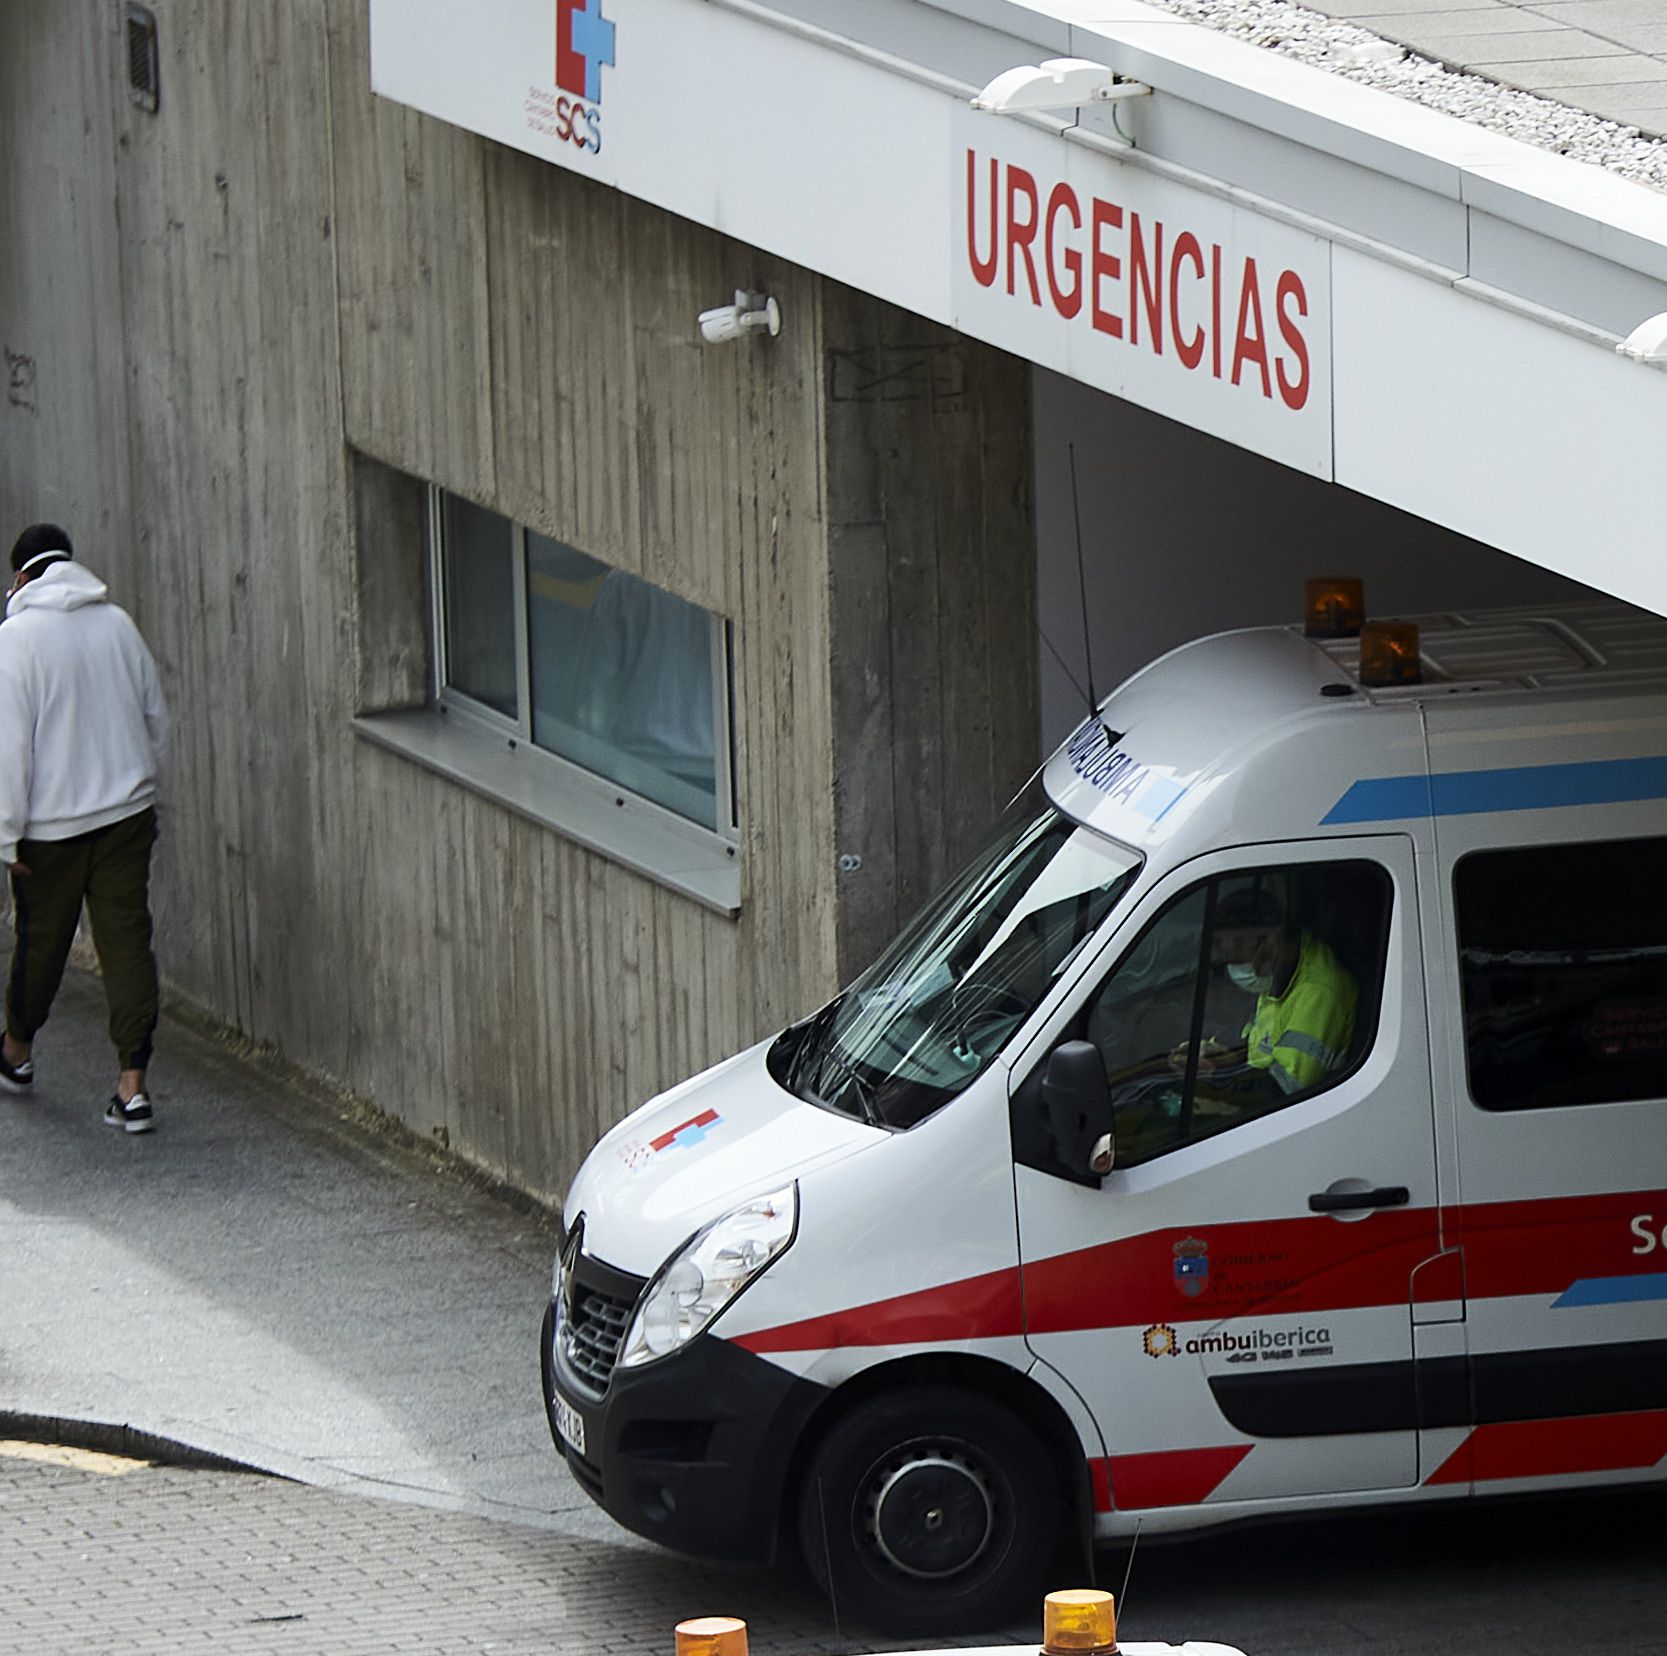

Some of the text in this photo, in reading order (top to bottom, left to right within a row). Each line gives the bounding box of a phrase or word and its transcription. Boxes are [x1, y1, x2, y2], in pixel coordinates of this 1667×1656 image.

[556, 96, 601, 154] SCS
[965, 147, 1310, 411] URGENCIAS
[1186, 1326, 1331, 1354] ambuiberica
